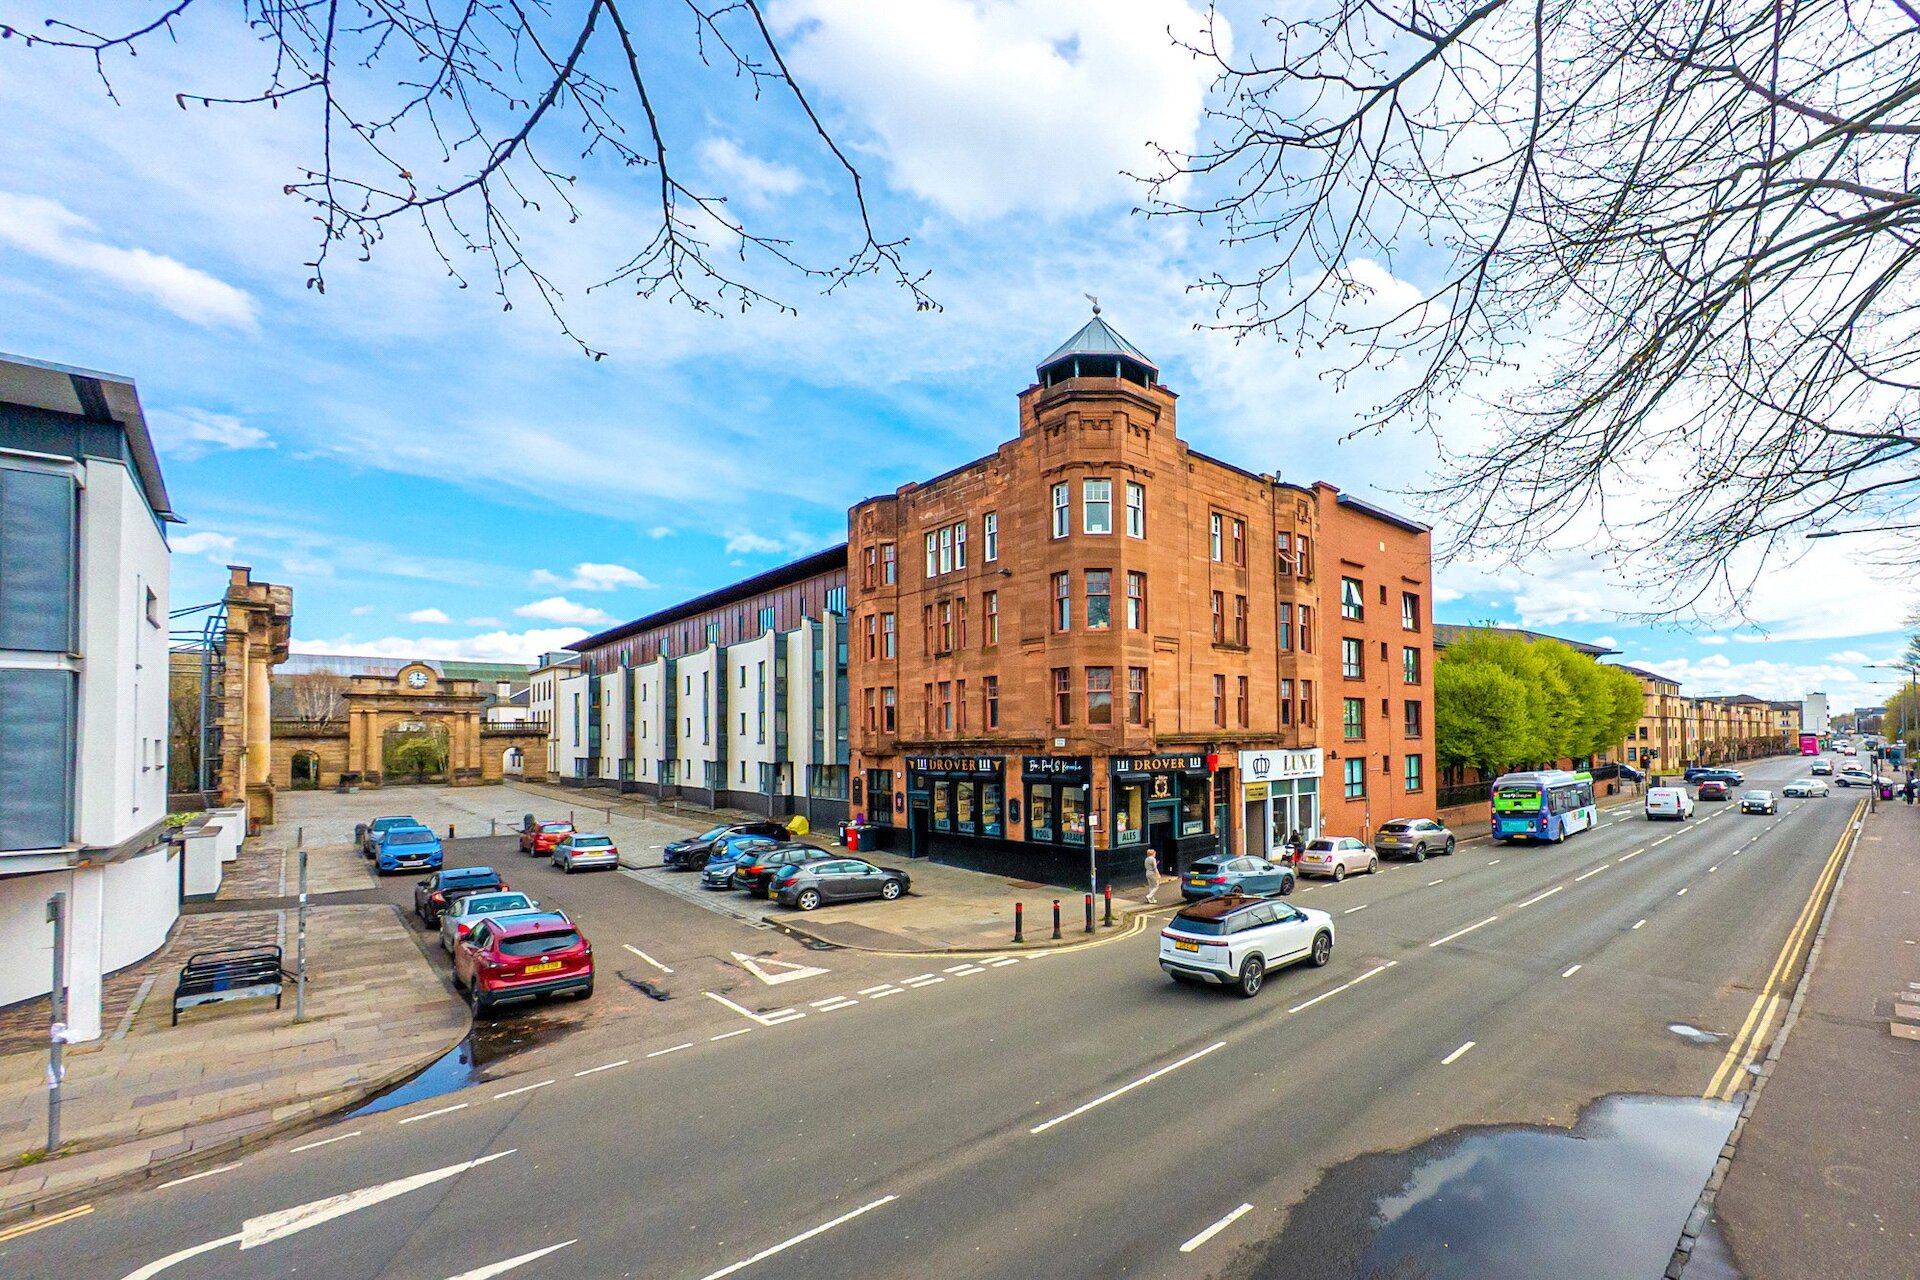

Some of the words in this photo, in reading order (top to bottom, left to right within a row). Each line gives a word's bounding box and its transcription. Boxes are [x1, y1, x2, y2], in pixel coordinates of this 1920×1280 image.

[929, 759, 976, 771] DROVER
[1134, 758, 1185, 770] DROVER
[1283, 754, 1317, 771] LUXE
[1035, 829, 1051, 839] POOL
[1122, 831, 1136, 841] ALES
